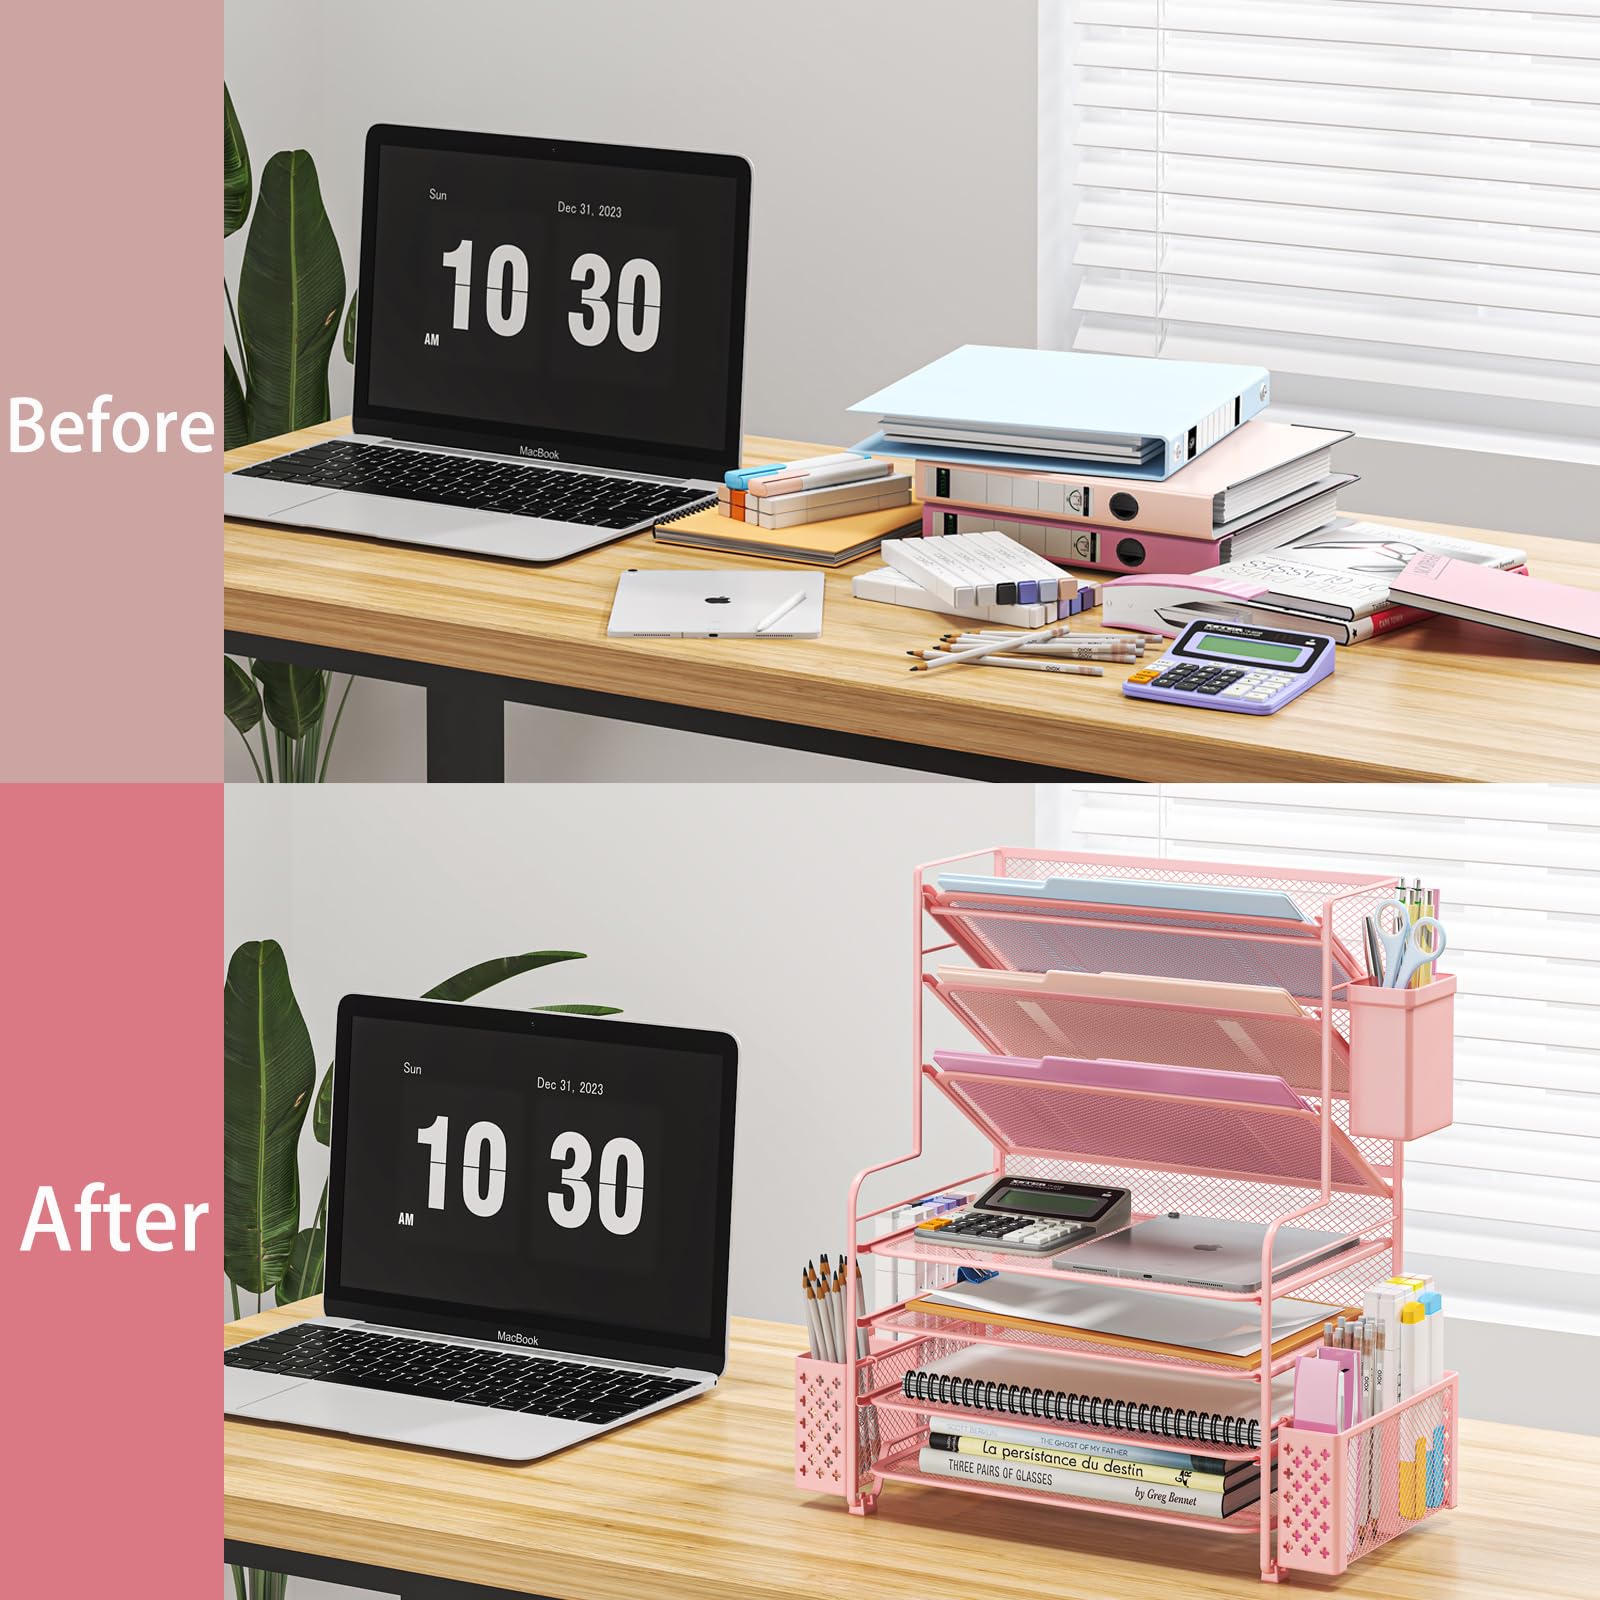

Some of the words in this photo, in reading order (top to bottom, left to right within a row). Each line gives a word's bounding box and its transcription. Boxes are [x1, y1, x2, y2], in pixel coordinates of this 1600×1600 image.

[429, 188, 447, 201] Sun
[557, 201, 577, 214] Dec
[579, 203, 595, 216] 31,
[598, 205, 622, 218] 2023
[442, 239, 529, 337] 10
[568, 253, 661, 352] 30
[424, 333, 440, 346] AM
[519, 445, 560, 461] MacBook
[403, 1061, 422, 1075] Sun
[537, 1076, 557, 1091] Dec
[559, 1079, 575, 1093] 31,
[579, 1081, 604, 1096] 2023
[417, 1115, 507, 1217] 10
[547, 1131, 645, 1235] 30
[398, 1211, 414, 1226] AM
[497, 1331, 539, 1346] MacBook
[1040, 1437, 1054, 1446] THE
[1054, 1439, 1079, 1450] GHOST
[1078, 1442, 1089, 1451] OF
[1089, 1443, 1101, 1452] MY
[1101, 1445, 1129, 1457] FATHER
[982, 1440, 998, 1455] La
[1002, 1447, 1078, 1467] persistance
[1081, 1455, 1099, 1471] du
[1103, 1459, 1144, 1477] destin
[948, 1458, 975, 1474] THREE
[976, 1463, 1001, 1478] PAIRS
[1002, 1467, 1014, 1480] OF
[1015, 1469, 1054, 1486] GLASSES
[1134, 1486, 1146, 1502] by
[1147, 1488, 1168, 1504] Greg
[1168, 1491, 1198, 1506] Bennet
